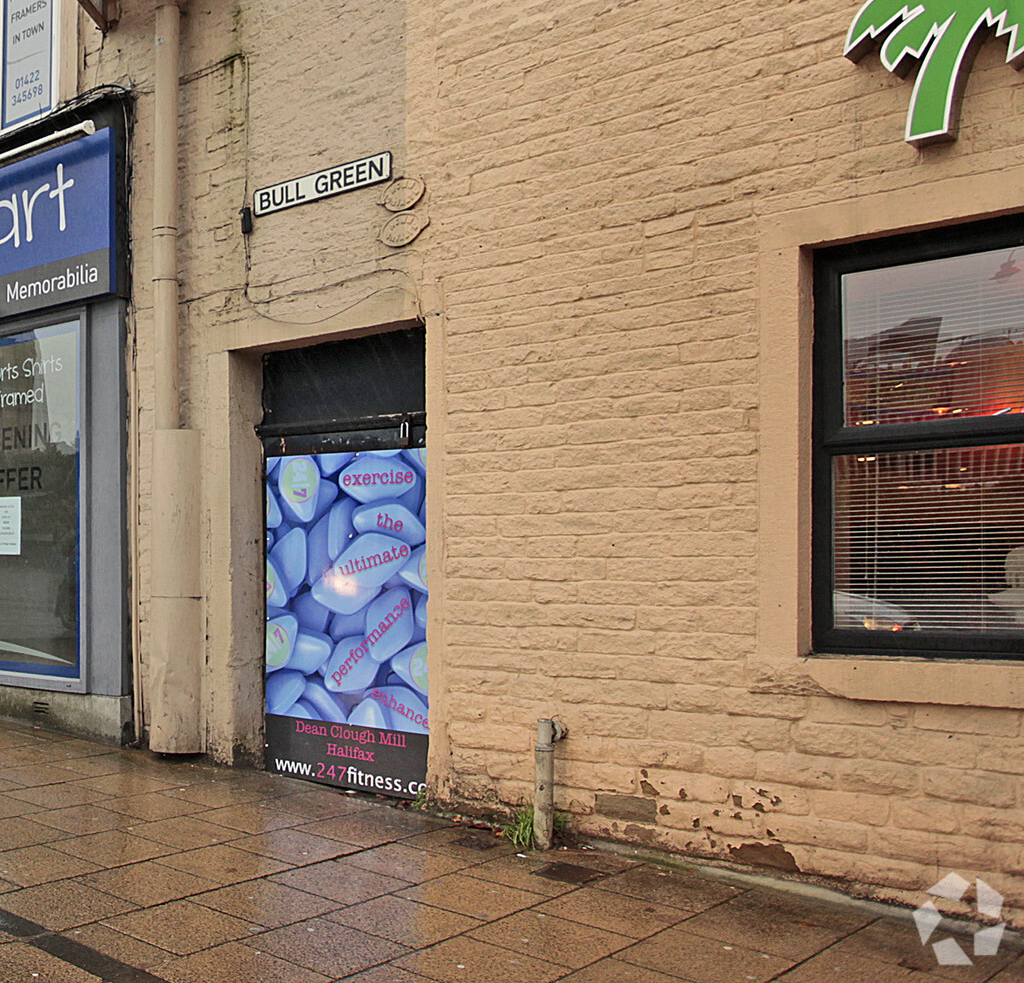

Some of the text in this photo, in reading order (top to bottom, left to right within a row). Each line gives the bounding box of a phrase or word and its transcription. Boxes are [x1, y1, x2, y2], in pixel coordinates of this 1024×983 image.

[13, 21, 44, 45] IN TOWN
[15, 69, 40, 90] 01422
[12, 84, 43, 107] 345698
[260, 157, 383, 210] BULL GREEN
[6, 265, 98, 303] Memorabilia
[22, 355, 62, 377] Shirts
[343, 470, 414, 486] exercise
[376, 513, 403, 532] the
[339, 544, 409, 576] ultimate
[331, 596, 411, 686] performance
[296, 721, 406, 747] Dean Clough Mill
[327, 743, 375, 762] Halifax
